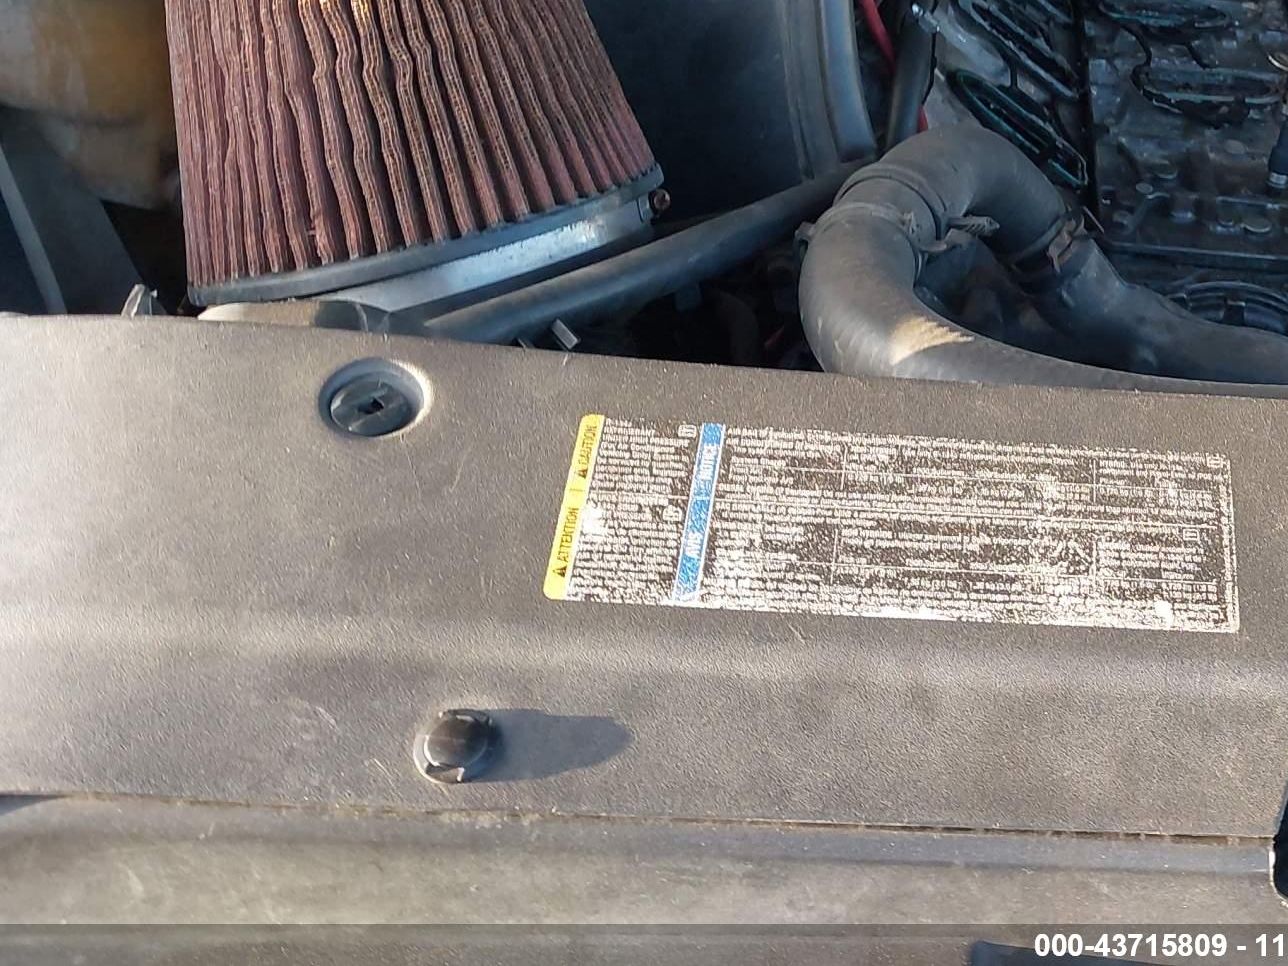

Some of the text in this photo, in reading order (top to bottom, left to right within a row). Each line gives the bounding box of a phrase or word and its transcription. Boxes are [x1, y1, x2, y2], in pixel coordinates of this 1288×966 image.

[578, 425, 597, 468] CAUTION
[697, 443, 721, 480] NOTICE
[561, 507, 579, 562] ATTENTION
[684, 532, 704, 558] AVIS
